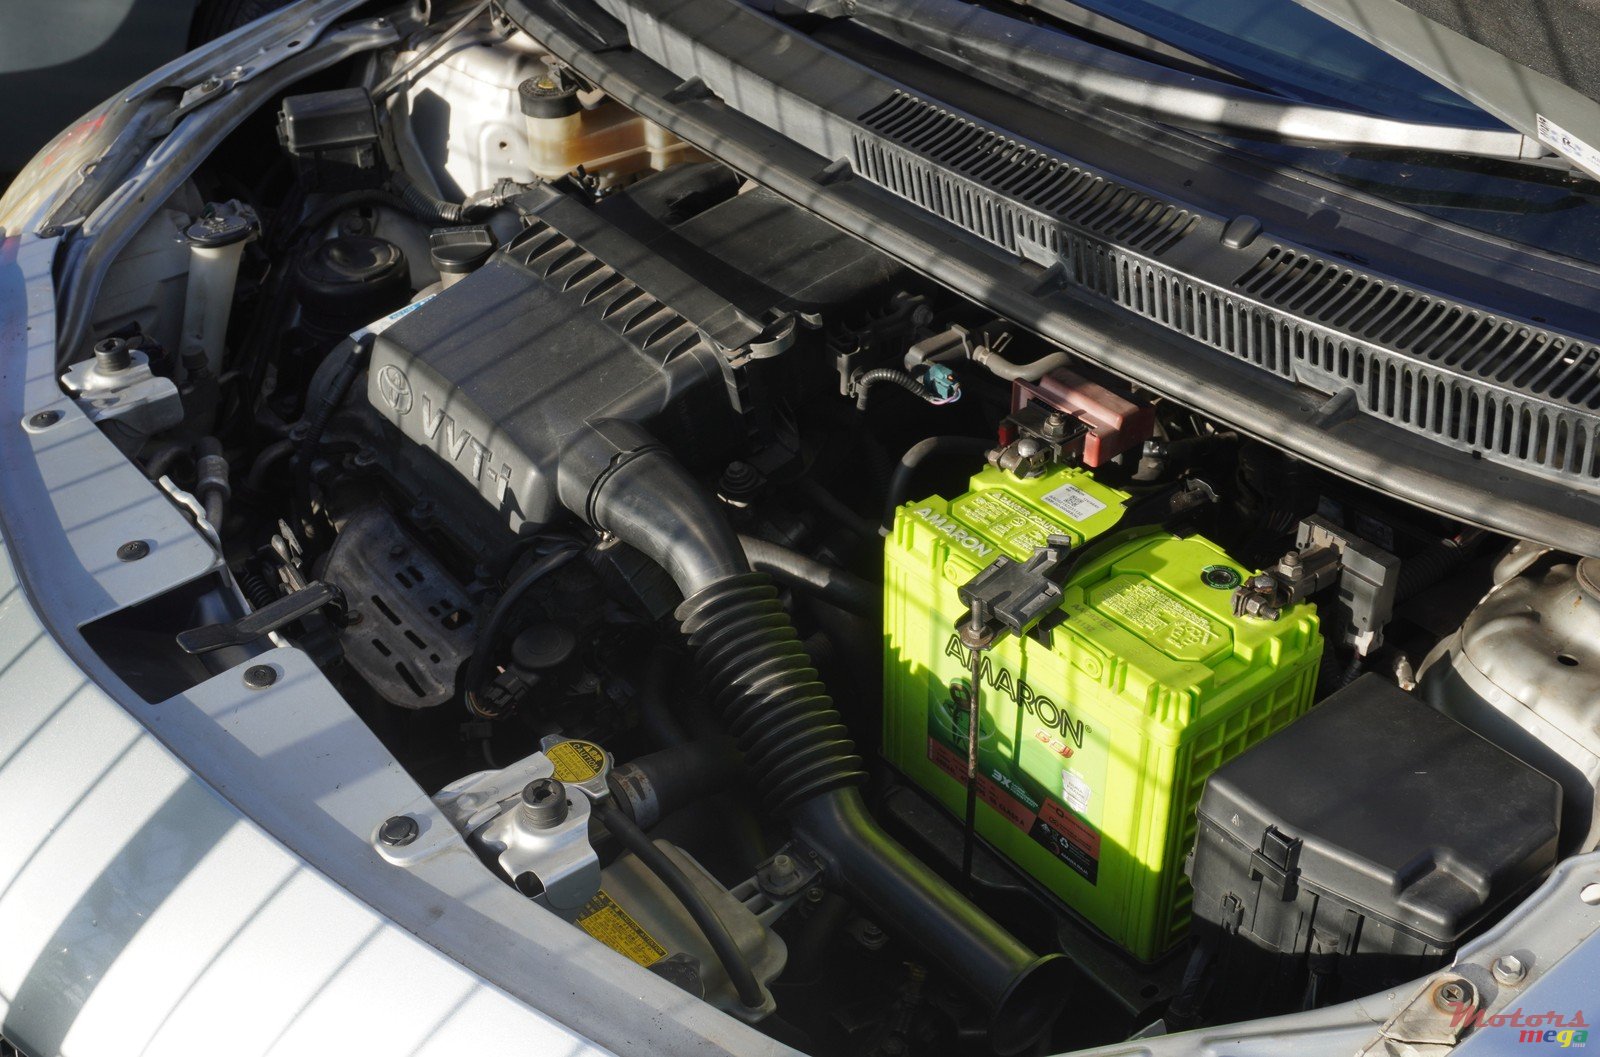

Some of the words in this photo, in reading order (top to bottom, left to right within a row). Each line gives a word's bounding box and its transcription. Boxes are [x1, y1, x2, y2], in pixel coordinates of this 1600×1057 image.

[422, 394, 512, 504] VVT-i
[914, 507, 992, 557] AMARON
[573, 743, 600, 770] CAUTION
